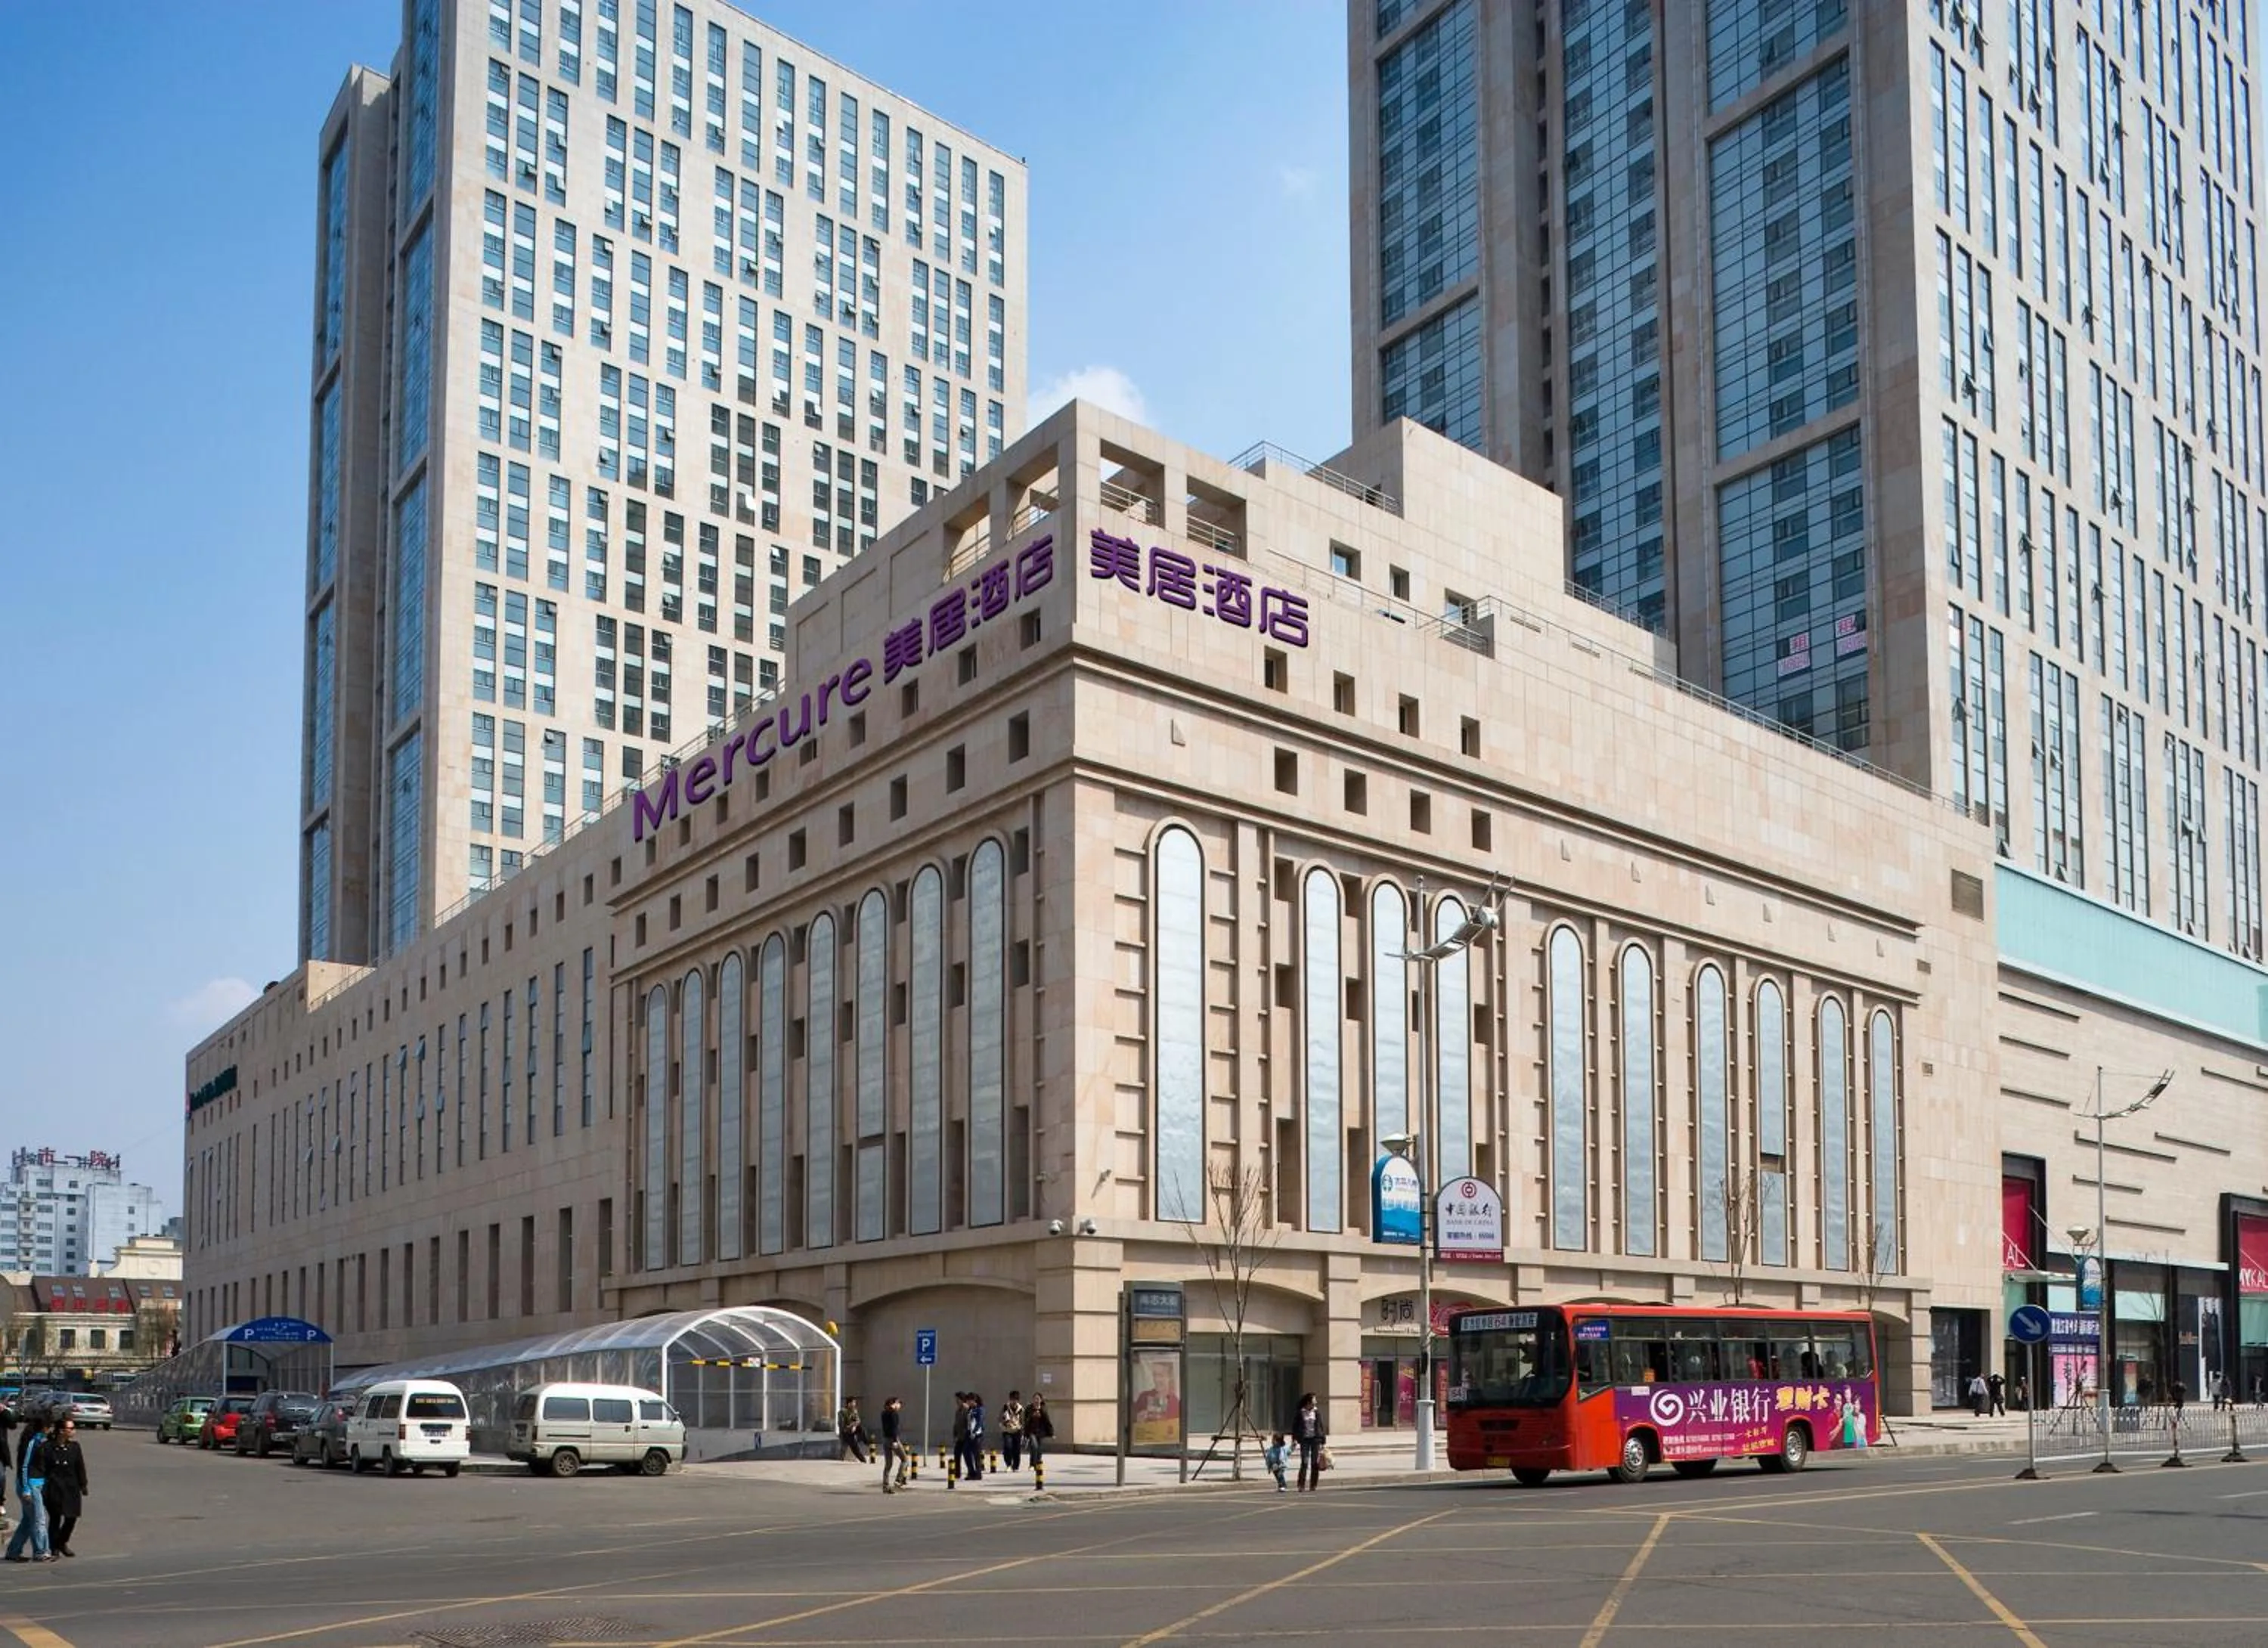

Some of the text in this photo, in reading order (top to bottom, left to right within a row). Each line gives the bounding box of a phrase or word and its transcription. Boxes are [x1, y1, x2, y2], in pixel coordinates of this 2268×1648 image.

[1090, 528, 1309, 648] 美居酒店
[632, 534, 1054, 843] Mercure 美居酒店
[1445, 1203, 1493, 1217] 中国银行
[2003, 1244, 2025, 1268] AL
[1381, 1298, 1414, 1326] 时尚
[244, 1328, 255, 1340] P
[306, 1329, 317, 1340] P
[922, 1337, 931, 1352] P
[1686, 1384, 1830, 1425] 兴业银行 理财卡
